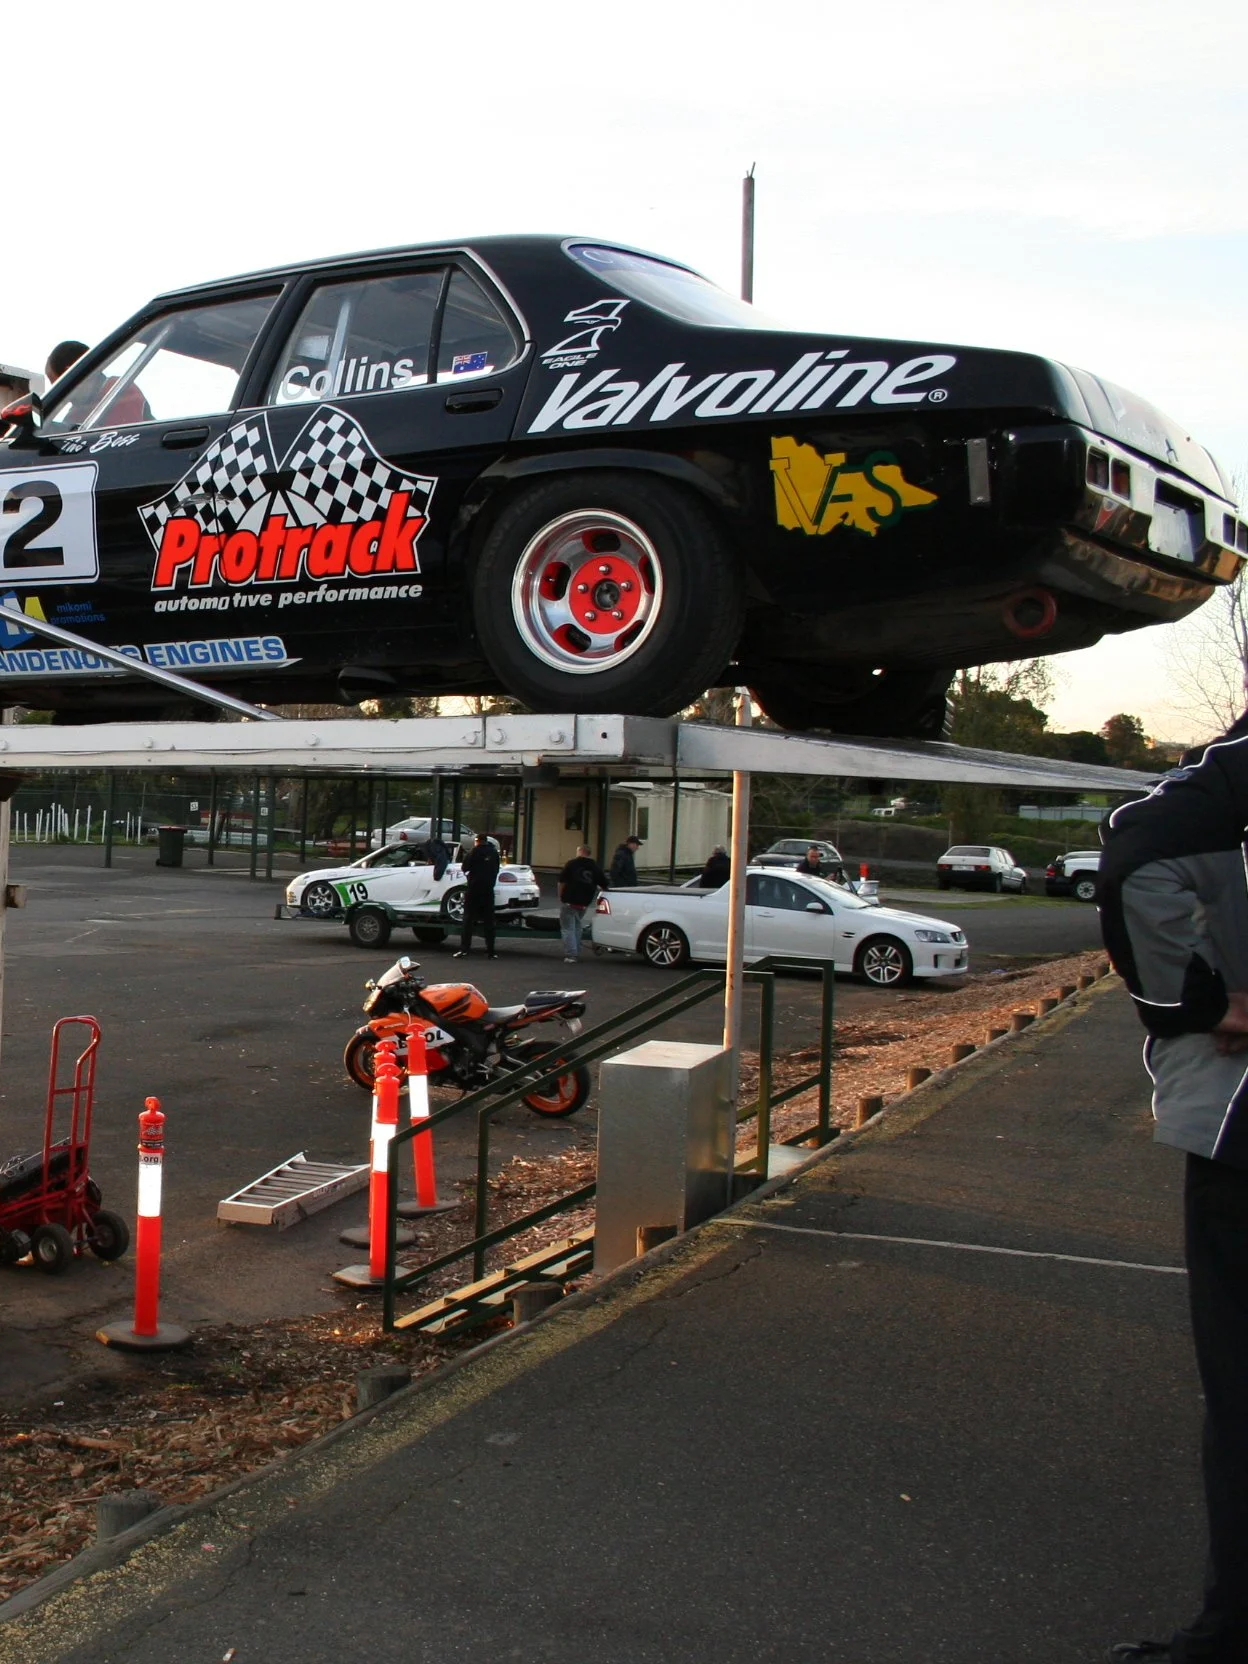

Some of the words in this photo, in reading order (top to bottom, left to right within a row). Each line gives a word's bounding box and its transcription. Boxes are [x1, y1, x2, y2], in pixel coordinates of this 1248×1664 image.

[541, 352, 598, 365] EAGLE
[549, 359, 588, 369] ONE
[281, 356, 414, 400] Collins
[527, 350, 956, 433] Valvoline
[89, 431, 141, 453] Boss
[2, 480, 64, 569] 2
[153, 490, 426, 590] Protrack
[56, 601, 92, 612] mikomi
[279, 584, 422, 609] performance
[149, 638, 285, 666] ENGINES
[349, 882, 368, 901] 19
